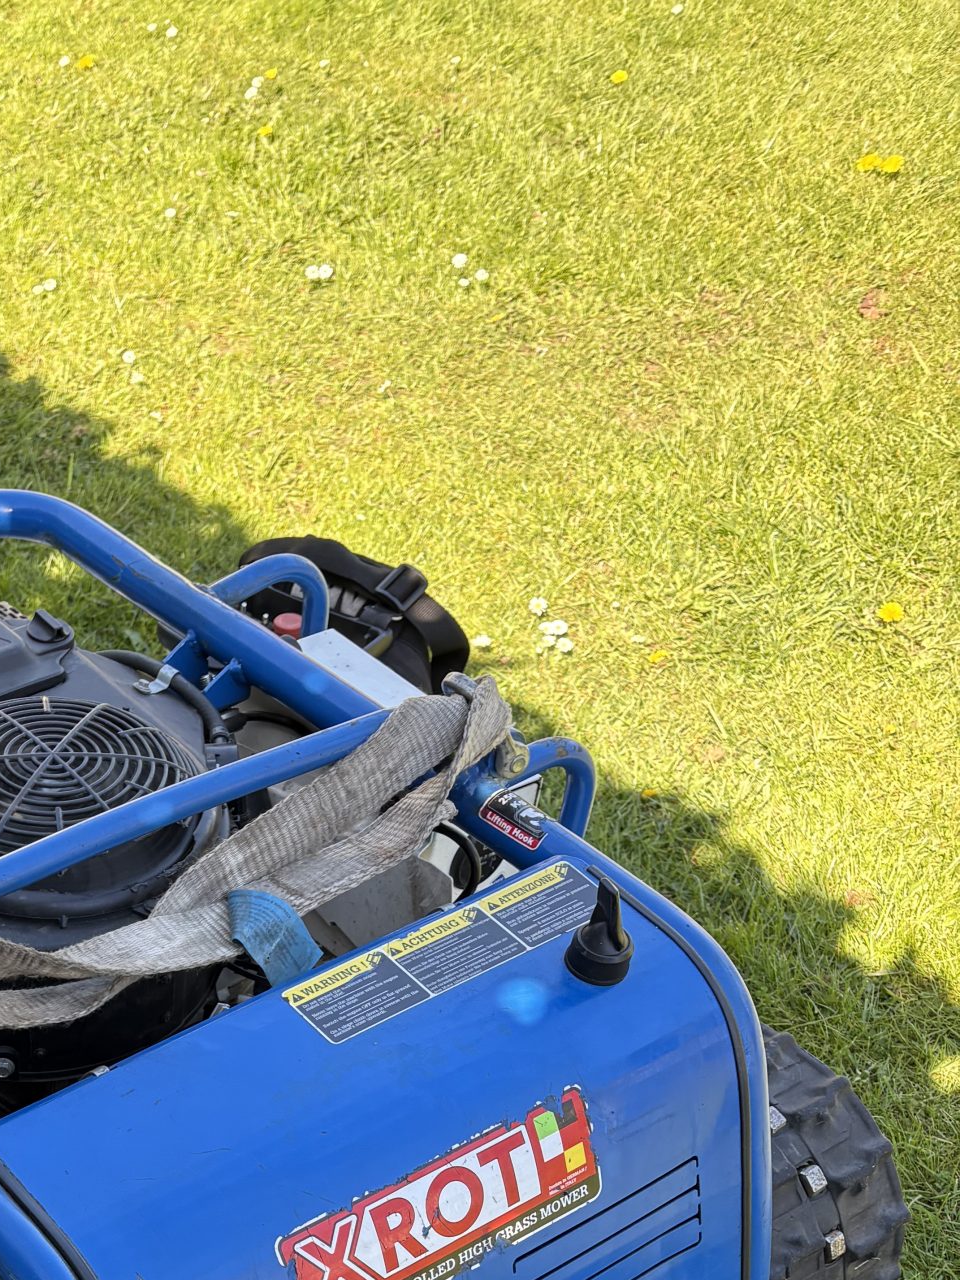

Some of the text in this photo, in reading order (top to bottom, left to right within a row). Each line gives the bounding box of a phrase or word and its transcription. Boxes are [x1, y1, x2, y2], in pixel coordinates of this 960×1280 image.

[486, 812, 534, 846] Lifting Hook
[498, 874, 557, 904] ATTENZIONE!
[401, 919, 459, 950] ACHTUNG
[302, 964, 361, 997] WARNING
[458, 1236, 493, 1265] HIGH
[496, 1210, 538, 1242] GRASS
[539, 1184, 589, 1220] MOWER
